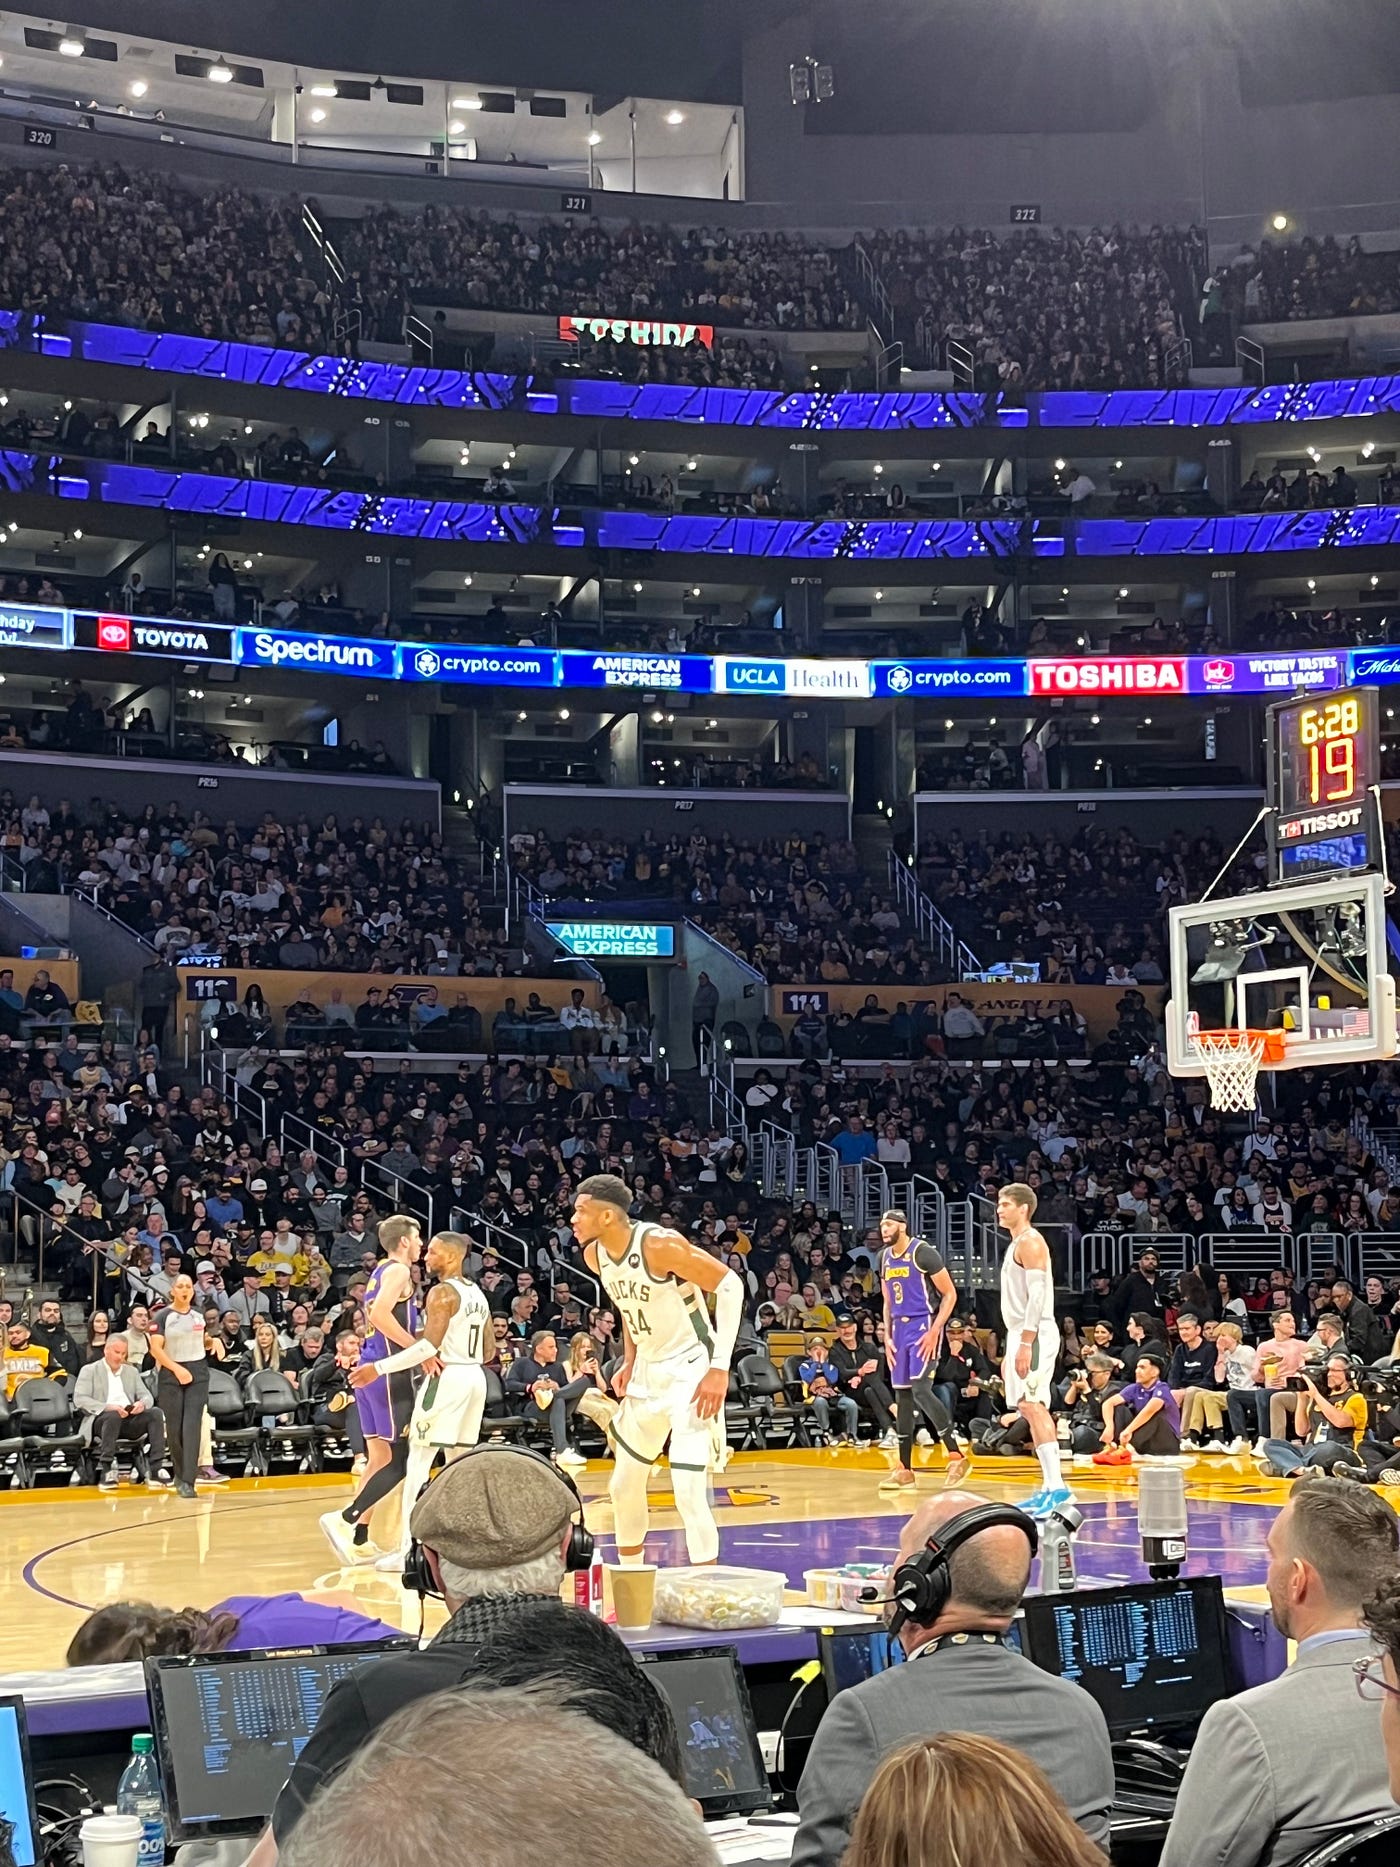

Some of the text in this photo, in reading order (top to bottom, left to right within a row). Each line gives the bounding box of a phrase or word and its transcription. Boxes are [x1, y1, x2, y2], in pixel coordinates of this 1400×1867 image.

[29, 131, 52, 144] 320
[566, 198, 585, 209] 321
[1015, 209, 1036, 221] 322
[133, 627, 209, 650] TOYOTA
[254, 633, 374, 667] Spectrum
[443, 656, 541, 673] crypto.com
[593, 656, 681, 673] AMERICAN
[1249, 656, 1338, 673] VICTORY TASTES
[605, 671, 682, 687] EXPRESS
[733, 668, 778, 685] UCLA
[793, 669, 859, 688] Health
[915, 670, 1011, 686] crypto.com
[1034, 664, 1180, 690] TOSHIBA
[1264, 670, 1325, 686] LIKE TACOS
[1301, 698, 1359, 745] 6:28
[1309, 737, 1354, 804] 19
[1300, 807, 1362, 835] TISSOT
[559, 924, 657, 941] AMERICAN
[573, 940, 658, 956] EXPRESS
[790, 995, 822, 1011] 114
[606, 1280, 650, 1303] UCKS
[623, 1309, 652, 1336] 34
[469, 1324, 481, 1359] 0
